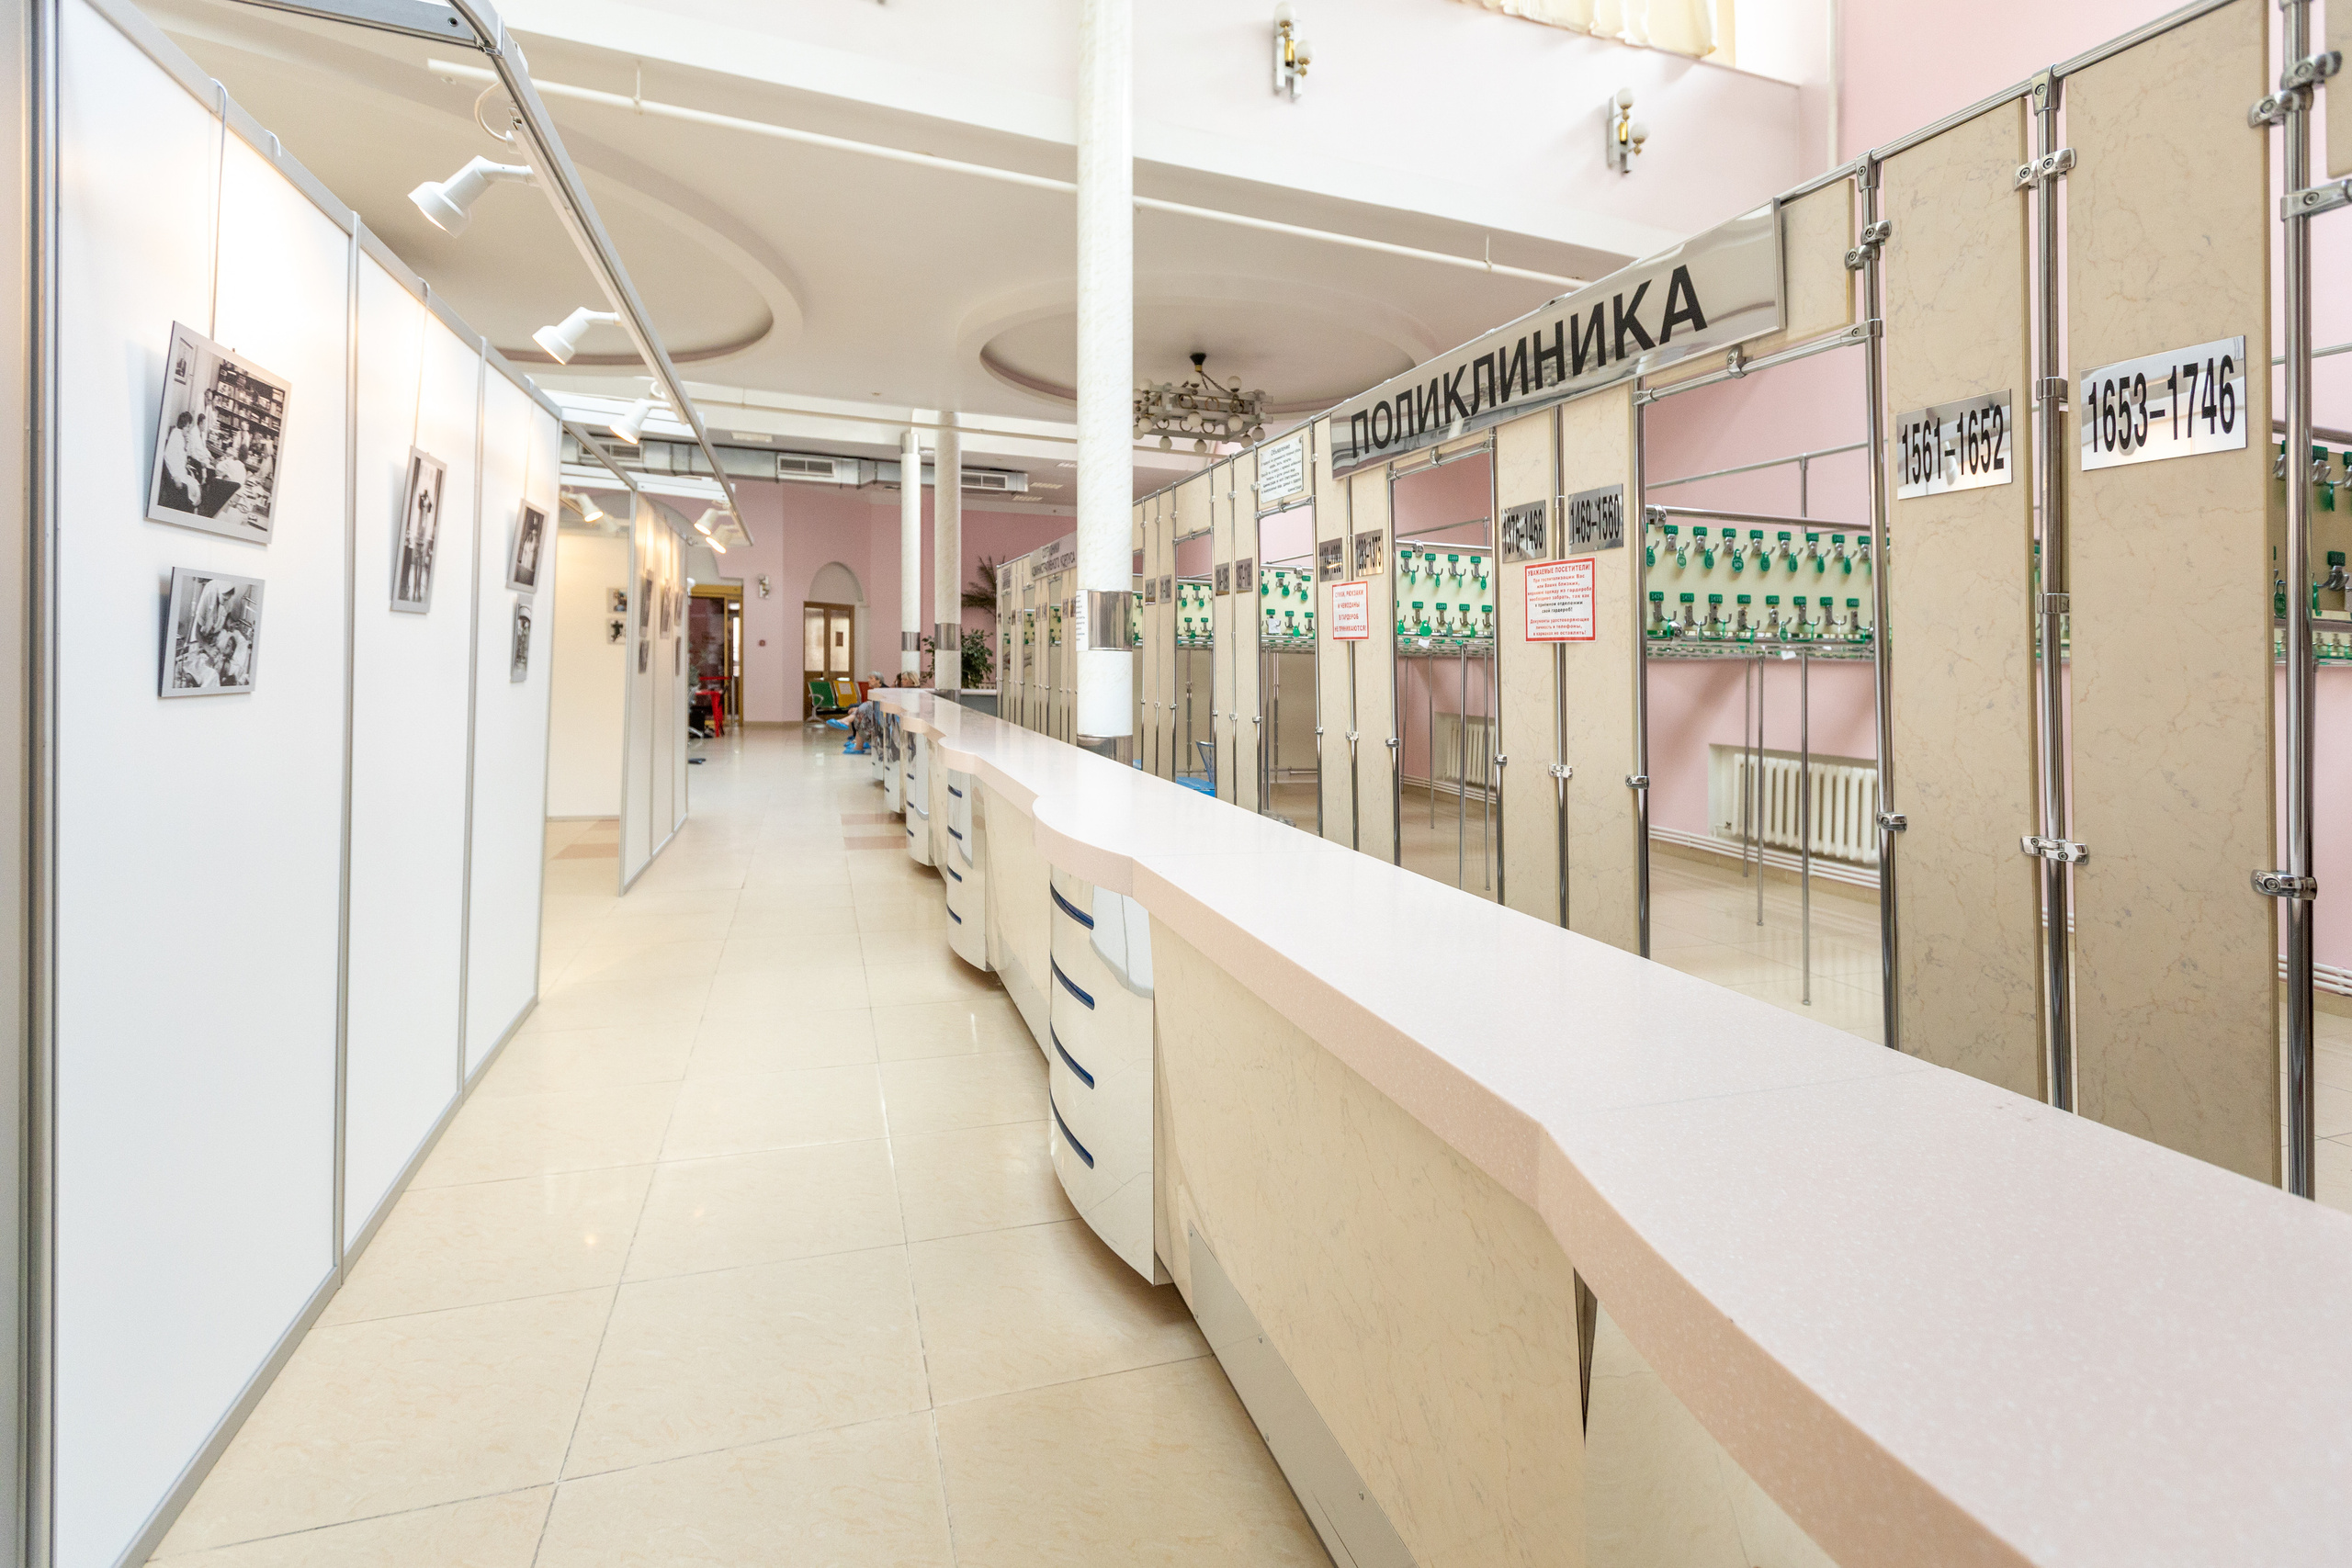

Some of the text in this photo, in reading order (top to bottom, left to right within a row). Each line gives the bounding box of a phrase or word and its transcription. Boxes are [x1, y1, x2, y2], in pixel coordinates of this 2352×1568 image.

[1351, 264, 1707, 458] ПОЛИКЛИНИКА
[2088, 355, 2234, 453] 1653-1746
[1902, 405, 2004, 484] 1561-1652
[1503, 508, 1543, 554] 1376-1468
[1571, 493, 1620, 544] 1469-1560
[1528, 564, 1590, 576] УВАЖАЕМЫЕ ПОСЕТИТЕЛИ!
